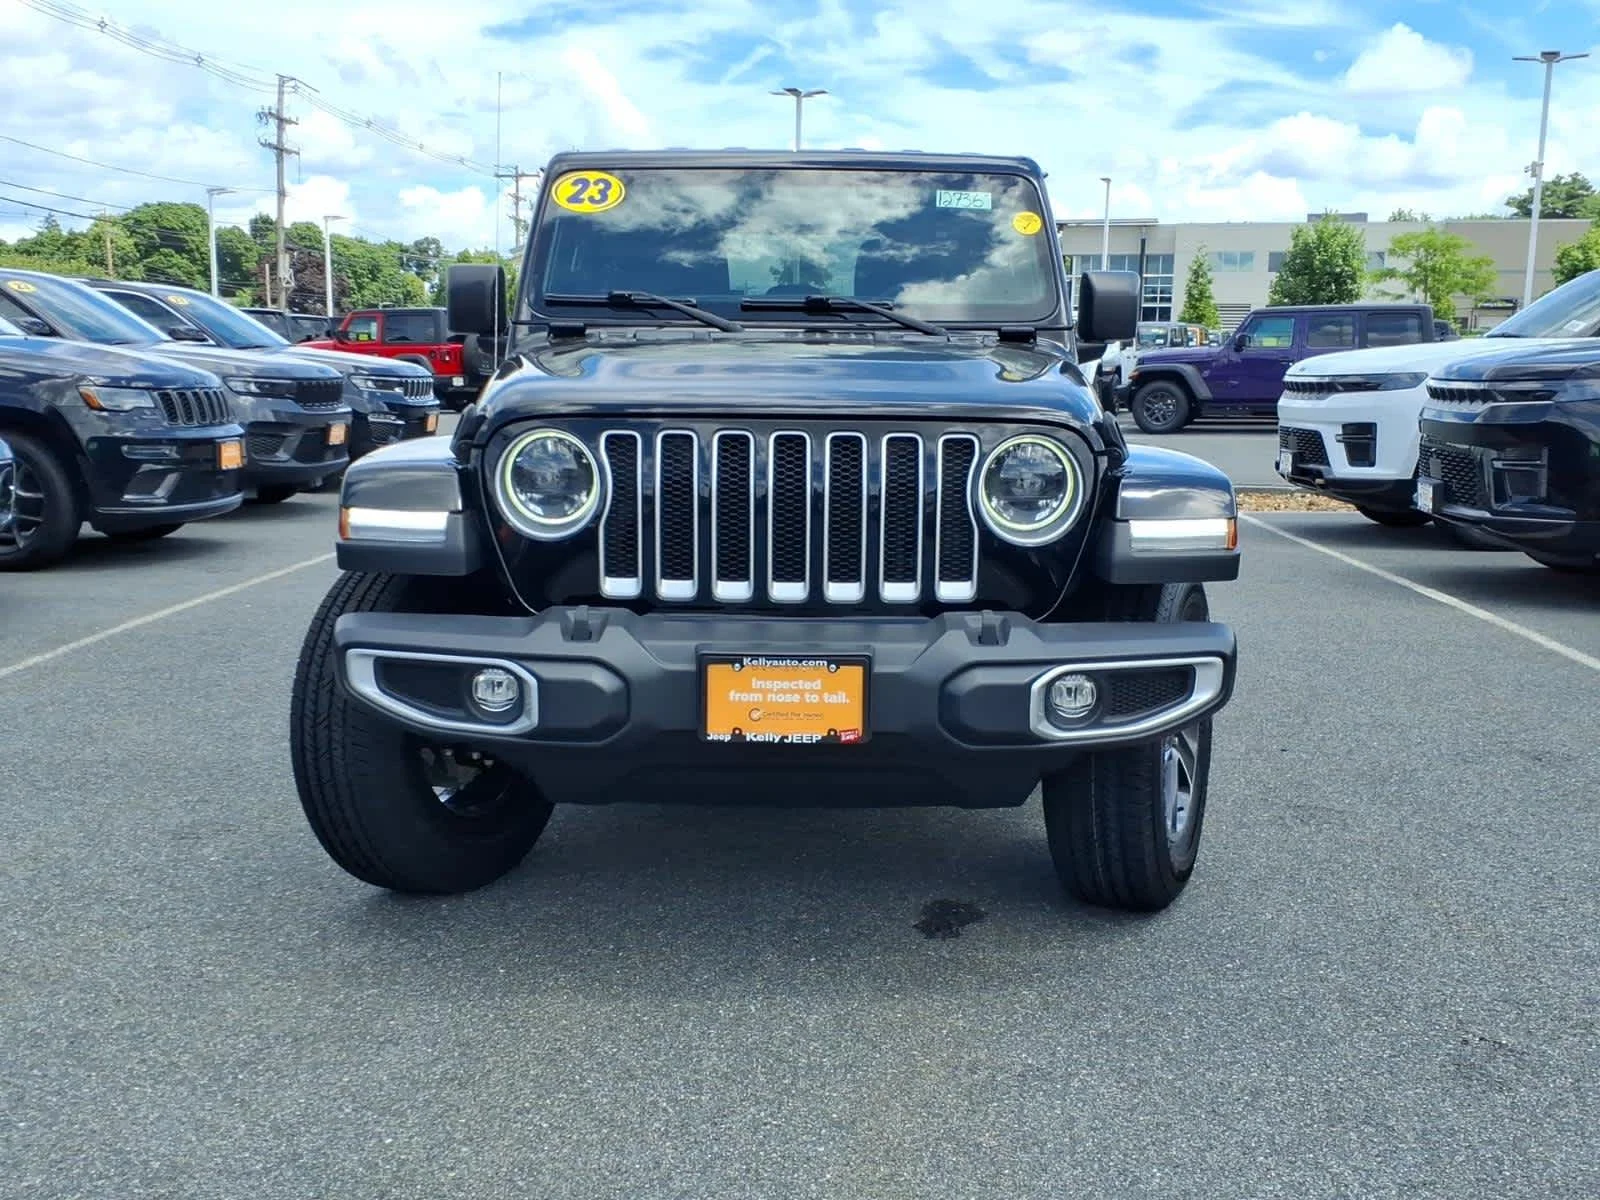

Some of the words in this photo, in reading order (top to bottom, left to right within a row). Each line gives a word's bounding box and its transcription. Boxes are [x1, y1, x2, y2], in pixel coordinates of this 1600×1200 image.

[566, 177, 612, 205] 23
[743, 657, 828, 667] Kellyauto.com
[751, 677, 822, 691] Inspected
[729, 691, 763, 702] from
[767, 693, 801, 703] nose
[804, 692, 820, 704] to
[823, 692, 850, 704] tail.
[707, 732, 731, 742] Jeep
[745, 732, 781, 743] Kelly
[784, 734, 822, 743] JEEP
